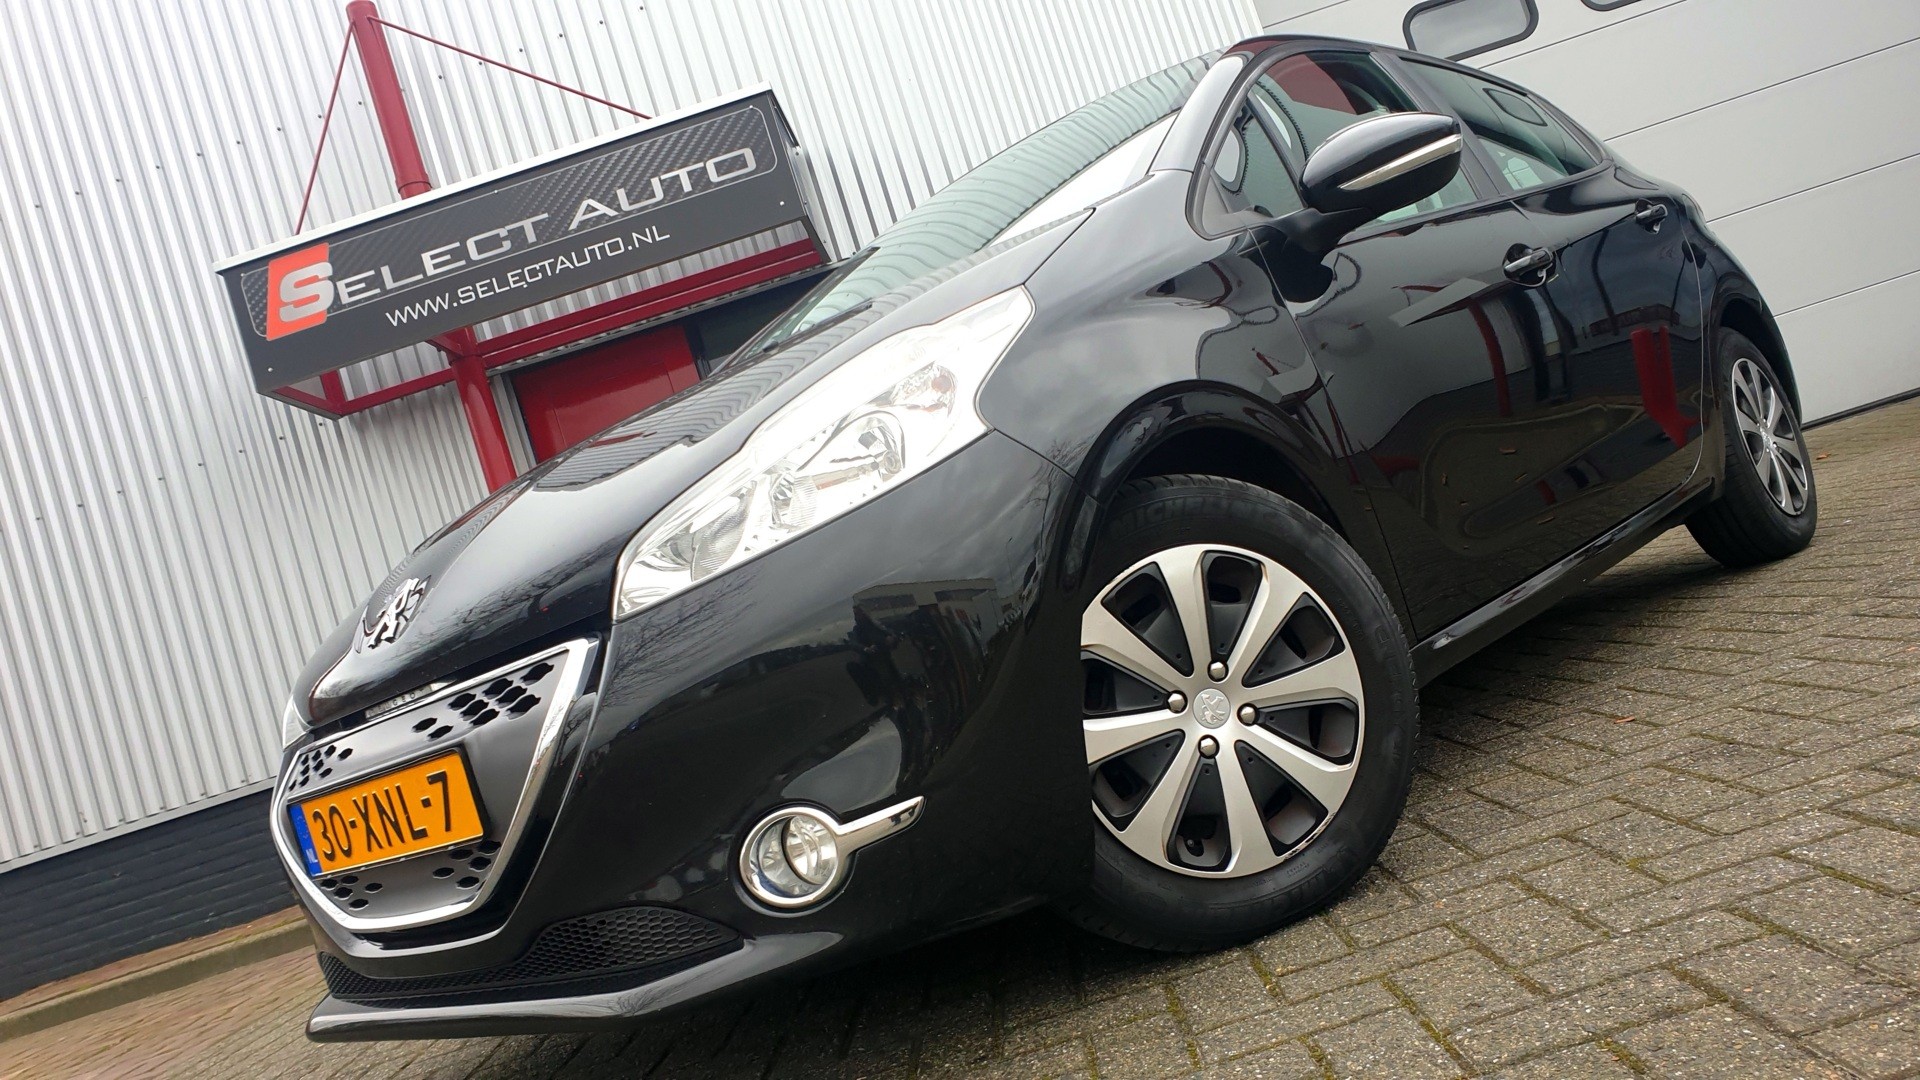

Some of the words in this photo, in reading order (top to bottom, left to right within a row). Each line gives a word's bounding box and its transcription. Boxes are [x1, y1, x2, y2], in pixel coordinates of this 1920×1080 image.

[279, 213, 548, 323] SELECT
[568, 147, 757, 231] AUTO
[385, 225, 671, 327] WWW.SELECTAUTO.NL
[312, 770, 452, 863] 30-XNL-7
